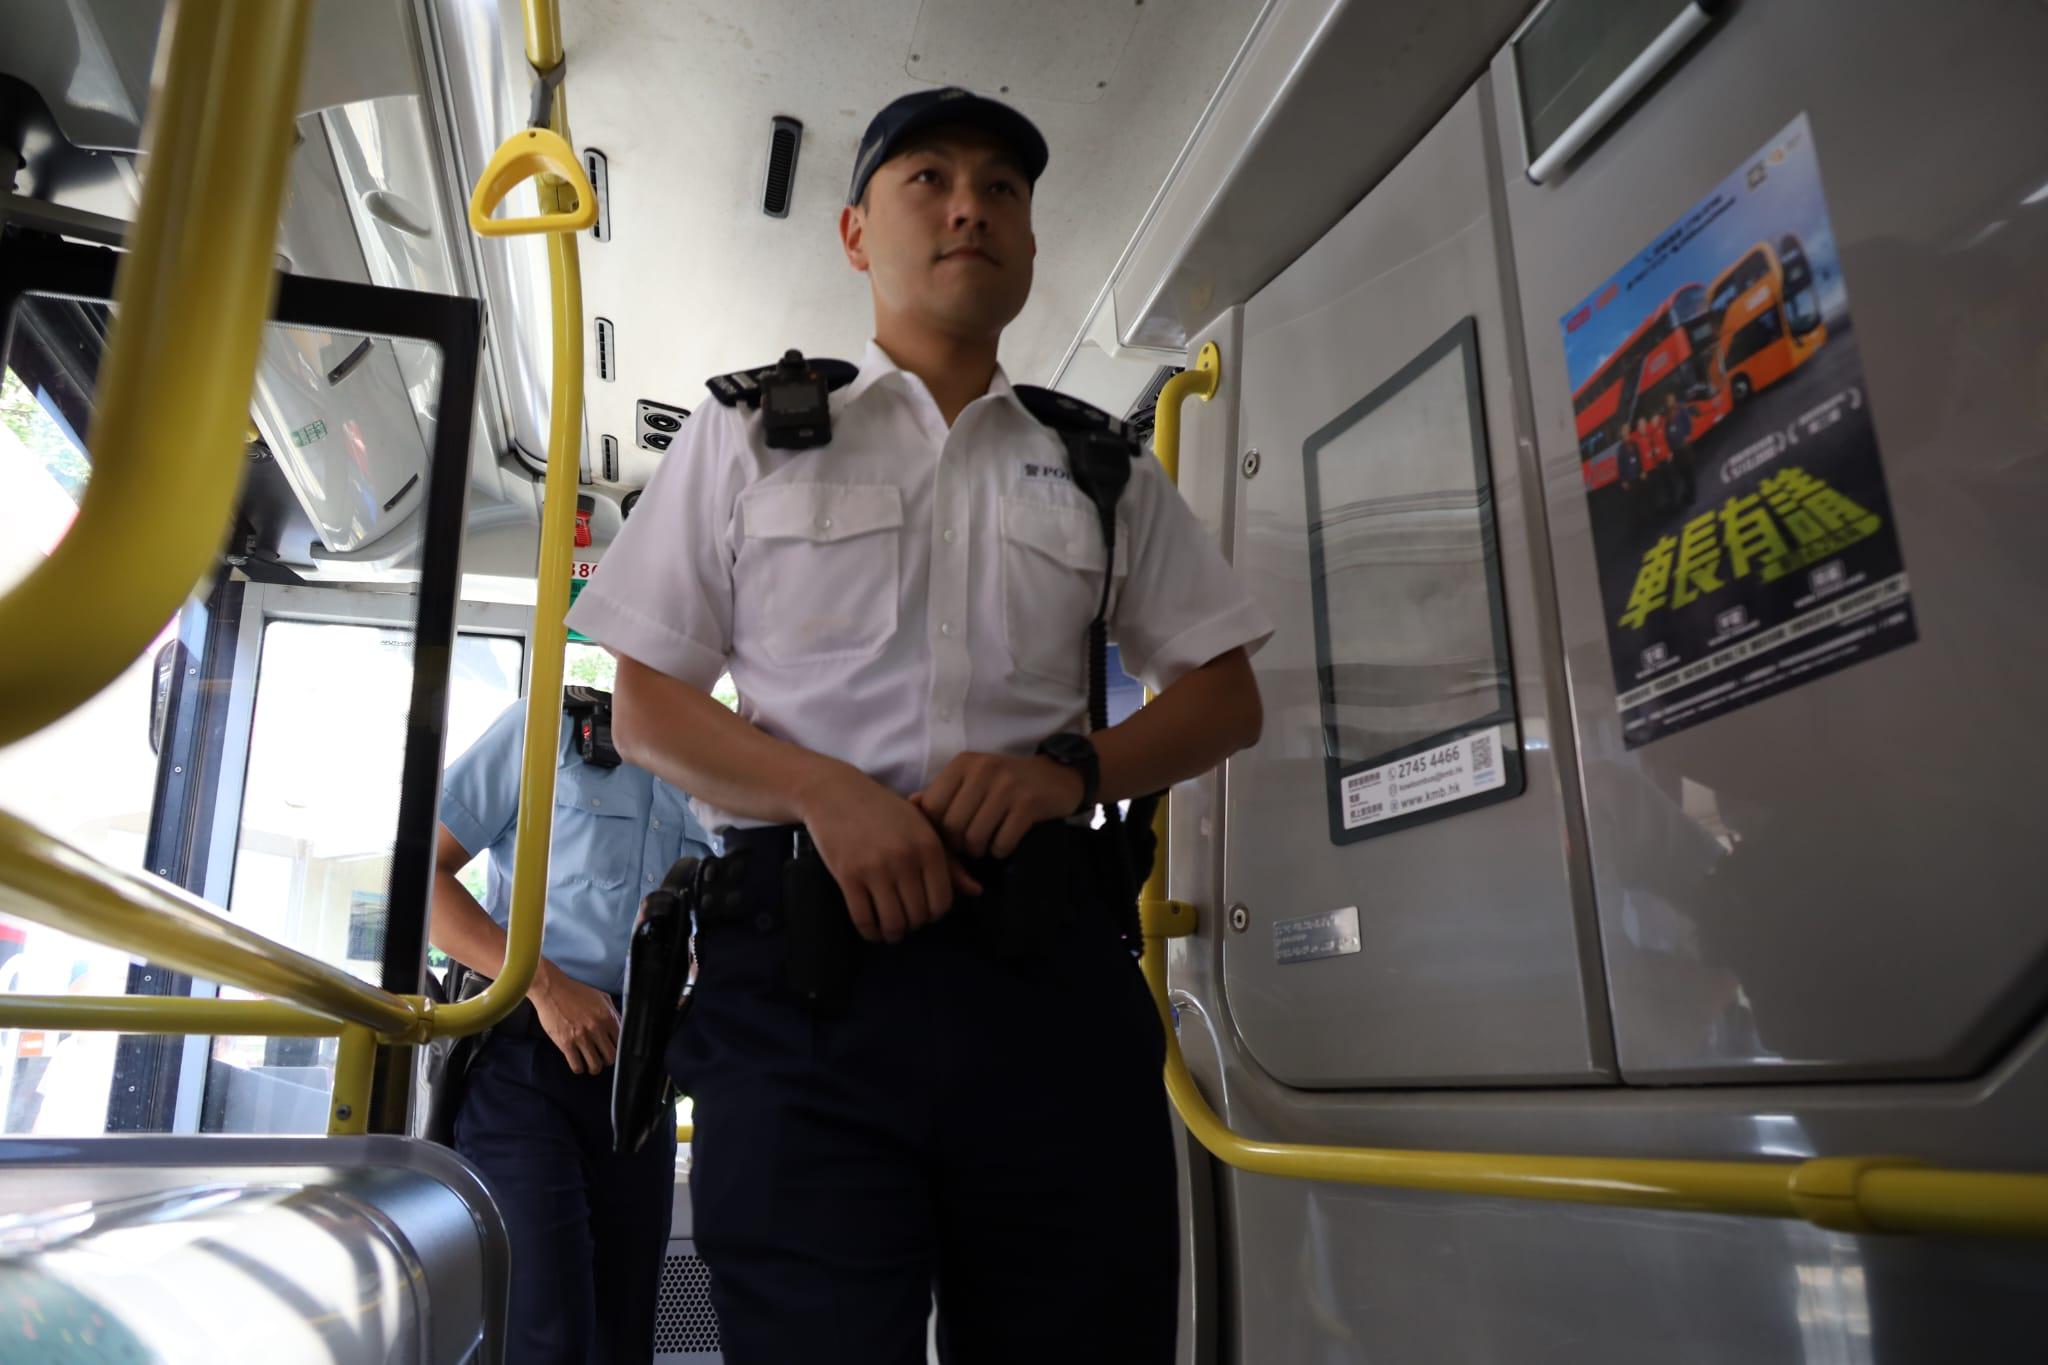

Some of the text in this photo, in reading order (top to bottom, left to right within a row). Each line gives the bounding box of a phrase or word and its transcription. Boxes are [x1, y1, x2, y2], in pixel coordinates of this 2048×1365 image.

[1398, 745, 1460, 778] 2745 4466
[1400, 782, 1460, 809] www.kmb.hk
